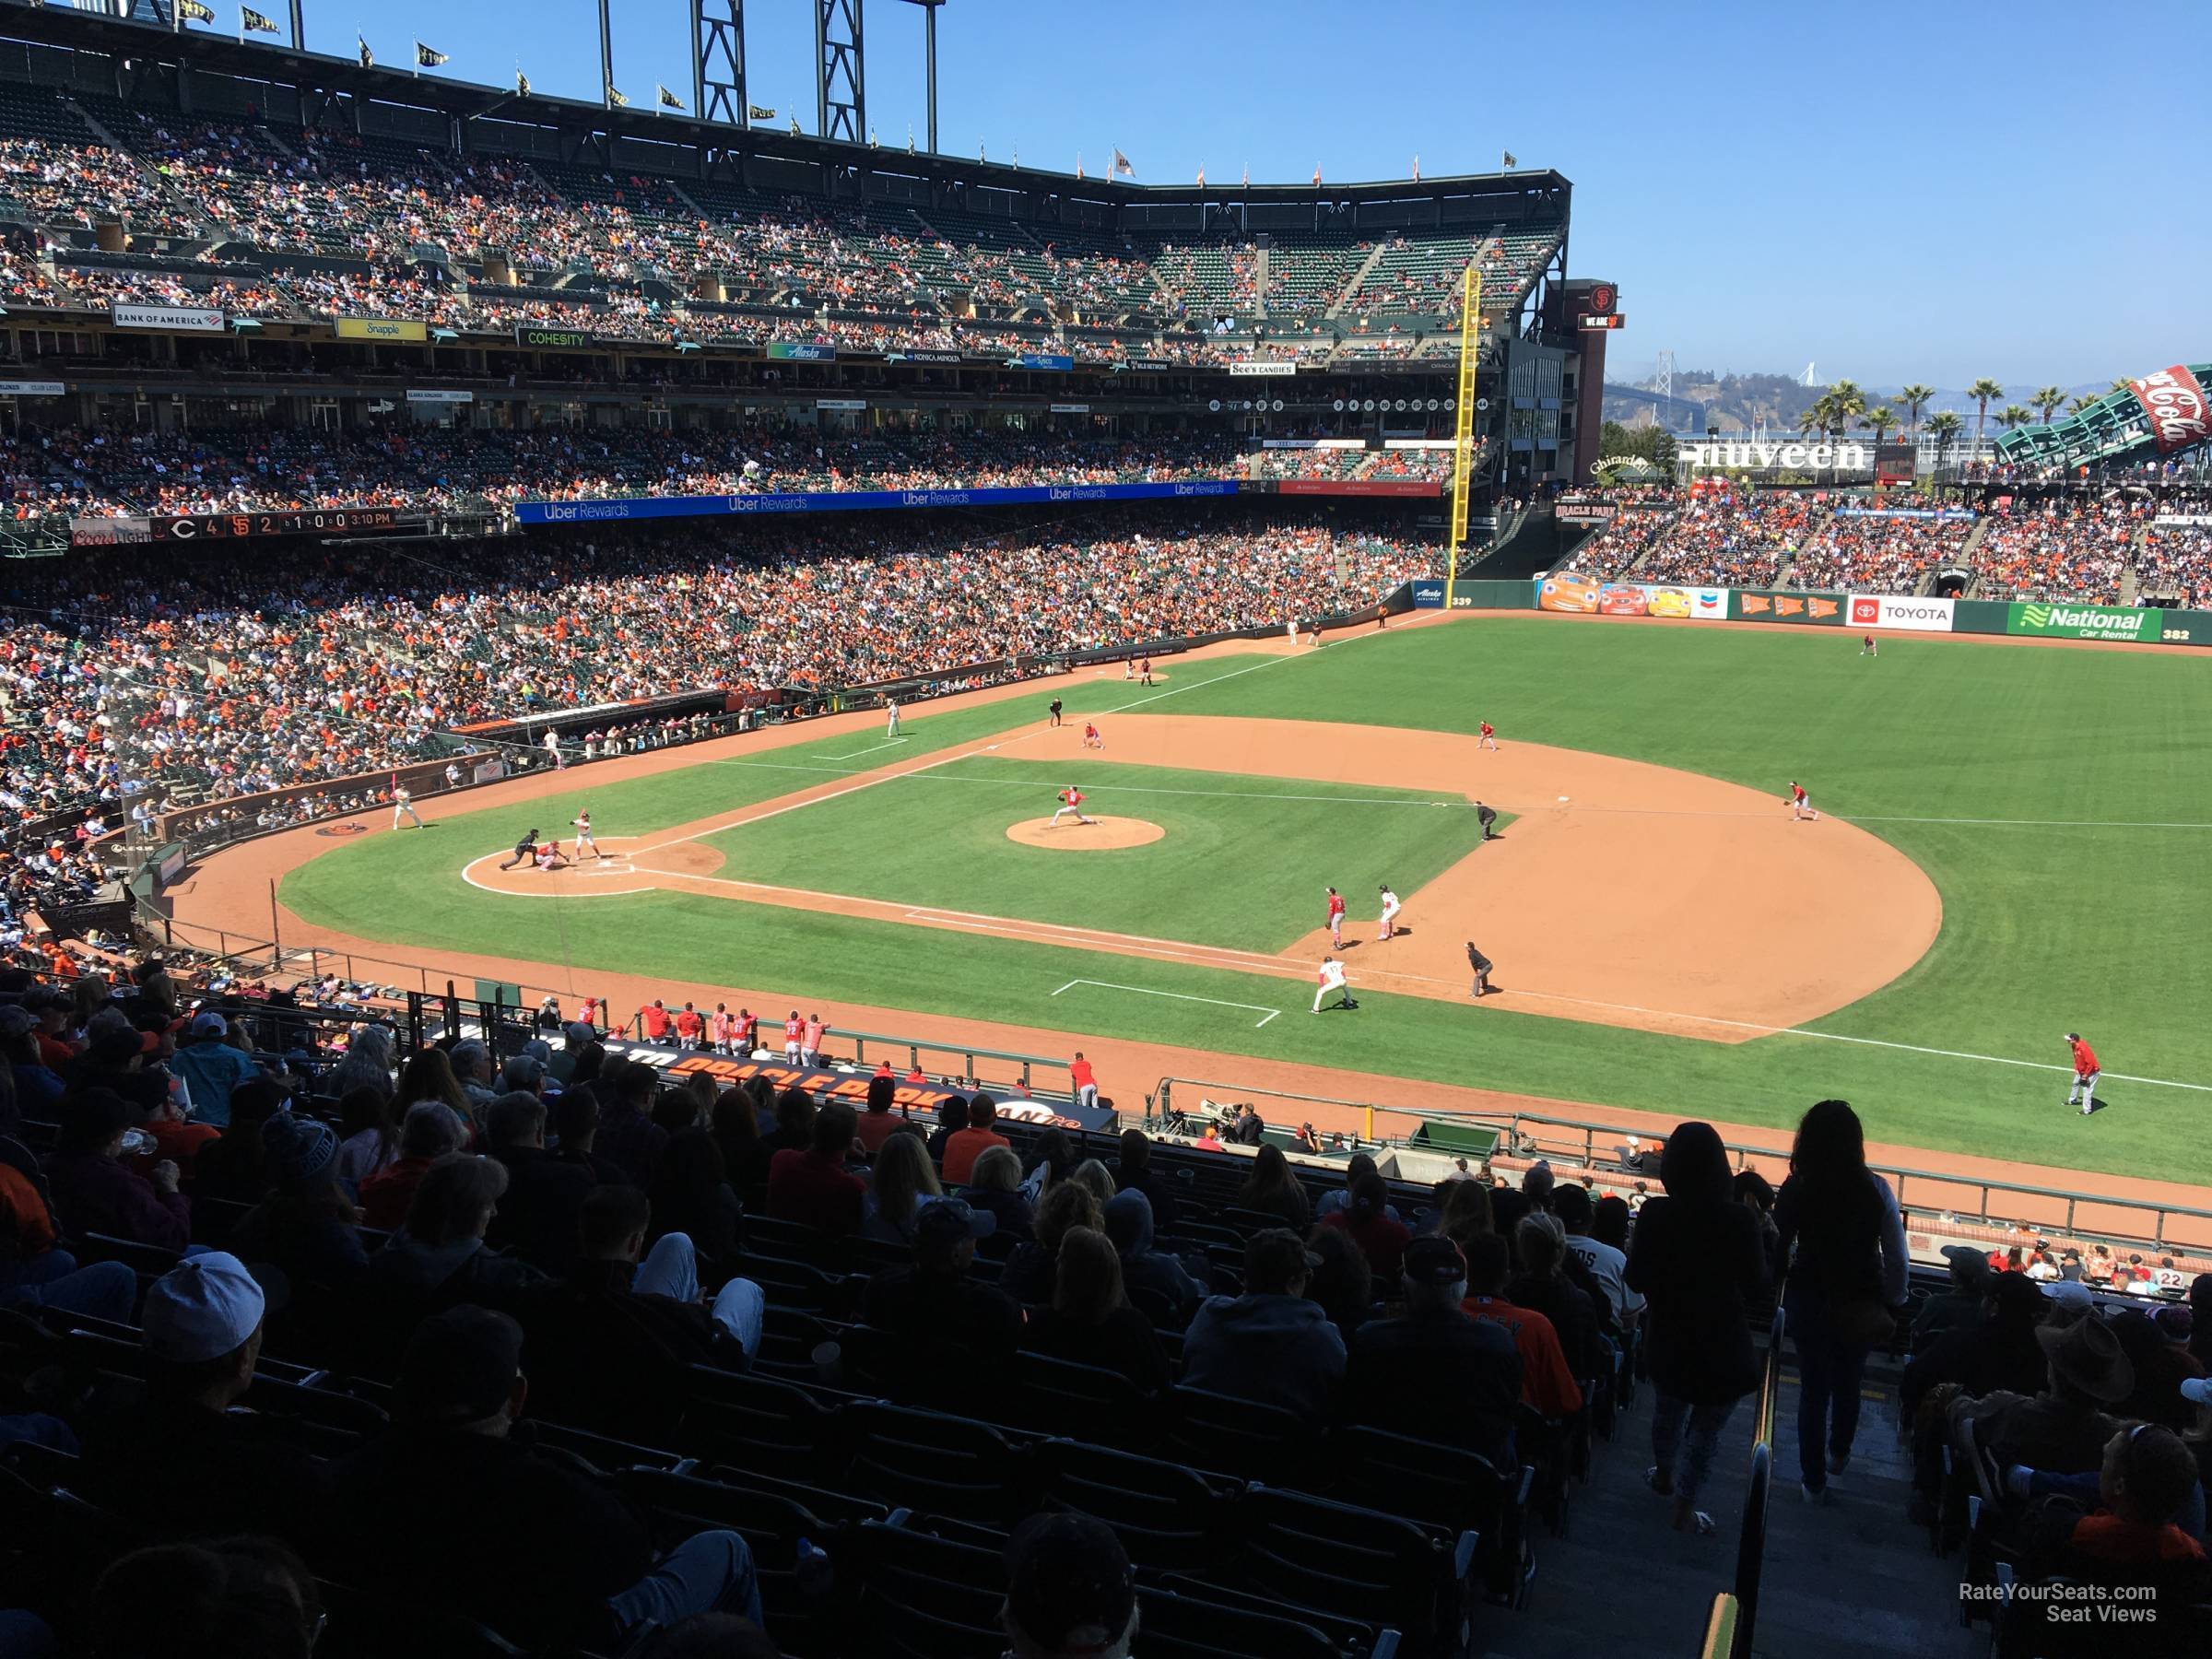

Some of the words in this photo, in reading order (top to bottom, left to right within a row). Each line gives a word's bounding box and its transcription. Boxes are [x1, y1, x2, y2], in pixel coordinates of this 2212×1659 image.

[117, 313, 144, 323] BANK
[160, 316, 203, 325] AMERICA
[1586, 317, 1596, 326] WE
[1596, 317, 1608, 326] ARE
[367, 323, 399, 335] Snapple
[528, 332, 584, 347] COHESITY
[788, 346, 819, 359] Alaska
[914, 353, 935, 362] KONICA
[936, 354, 960, 363] MINOLTA
[1232, 364, 1256, 373] See's
[1692, 443, 1865, 469] nuveen
[1049, 488, 1072, 500] Uber
[1073, 487, 1107, 500] Rewards
[1175, 484, 1194, 496] Uber
[1195, 482, 1225, 495] Rewards
[728, 497, 758, 512] Uber
[760, 496, 807, 511] Rewards
[902, 491, 929, 505] Uber
[931, 491, 969, 505] Rewards
[545, 504, 577, 520] Uber
[579, 502, 629, 519] Rewards
[1556, 505, 1591, 517] ORACLE
[1592, 506, 1616, 517] PARK
[206, 519, 217, 535] 4
[261, 516, 272, 532] 2
[314, 514, 323, 528] 0
[336, 513, 345, 527] 0
[351, 513, 372, 525] 3:10
[375, 512, 390, 524] PM
[74, 529, 115, 546] Coors
[117, 531, 151, 543] LIGHT
[1452, 597, 1472, 606] 339
[1885, 606, 1947, 620] TOYOTA
[2048, 608, 2145, 629] National
[2079, 629, 2099, 639] Car
[2101, 629, 2138, 641] Rental
[2162, 629, 2190, 640] 382
[2160, 1272, 2181, 1287] 22
